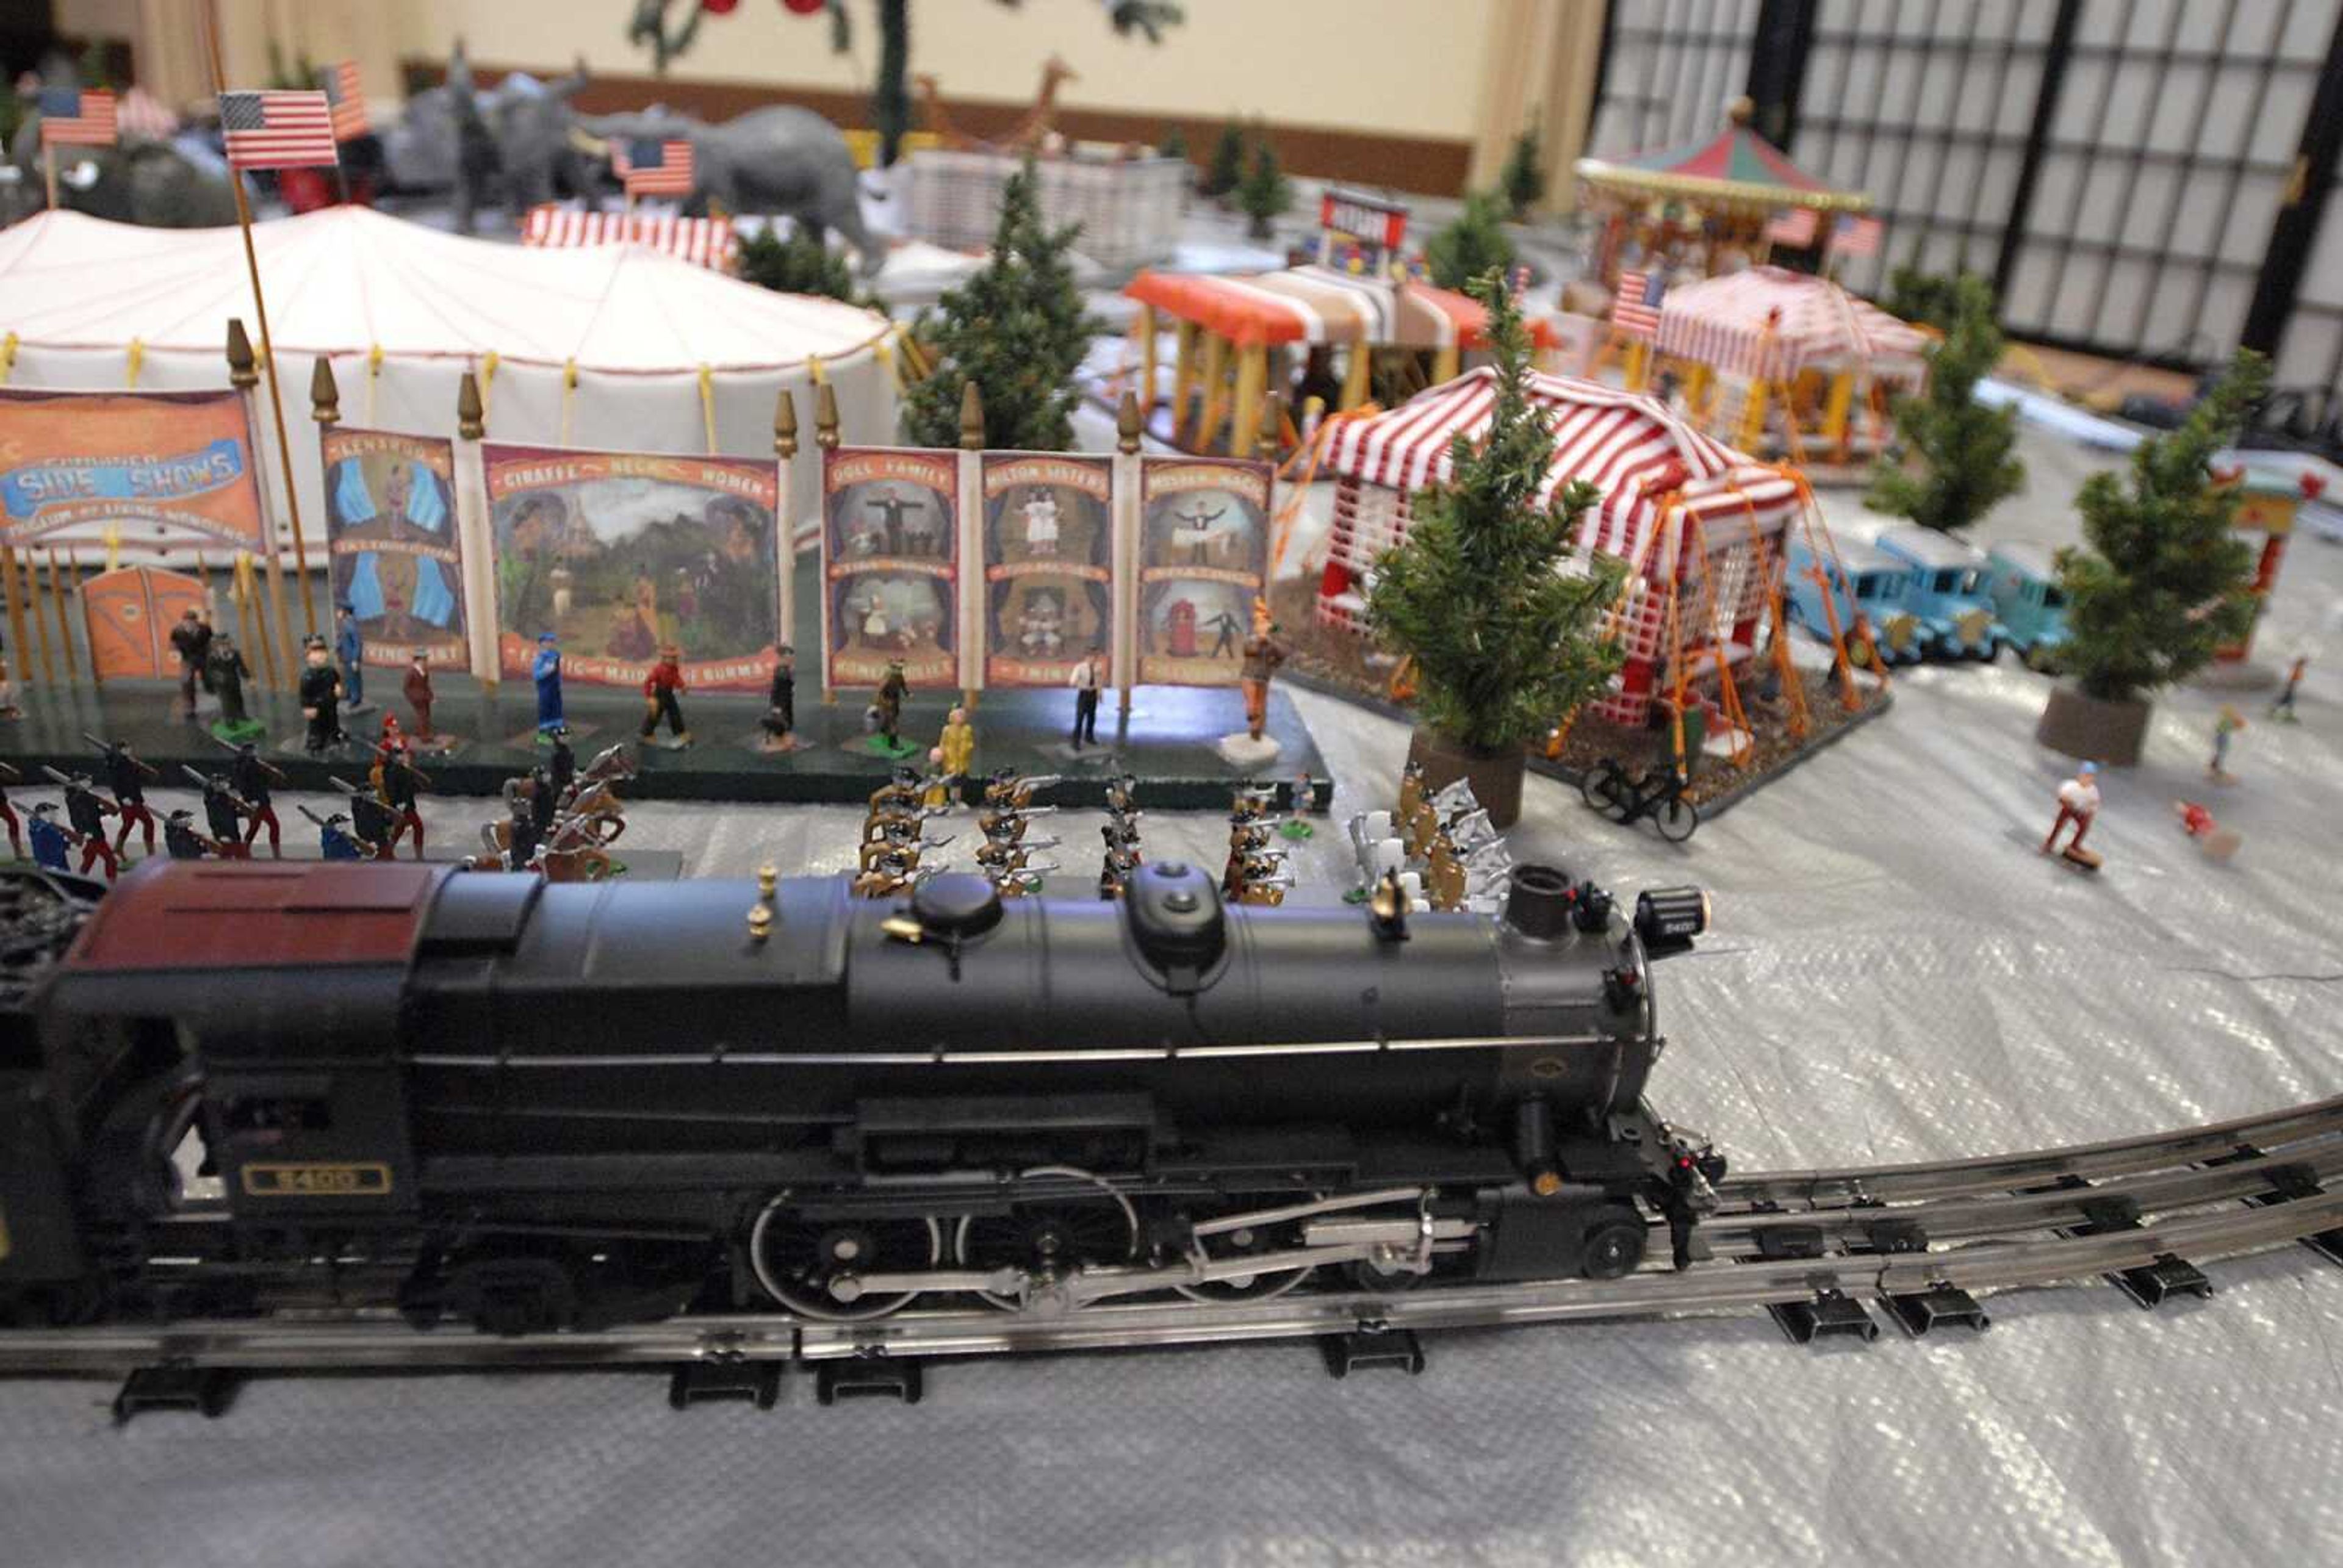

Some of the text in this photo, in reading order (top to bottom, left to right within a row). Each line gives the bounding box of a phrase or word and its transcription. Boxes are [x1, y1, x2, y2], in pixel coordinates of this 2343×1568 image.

[16, 452, 236, 502] SIDE SHOWS
[702, 467, 763, 493] WOMEN
